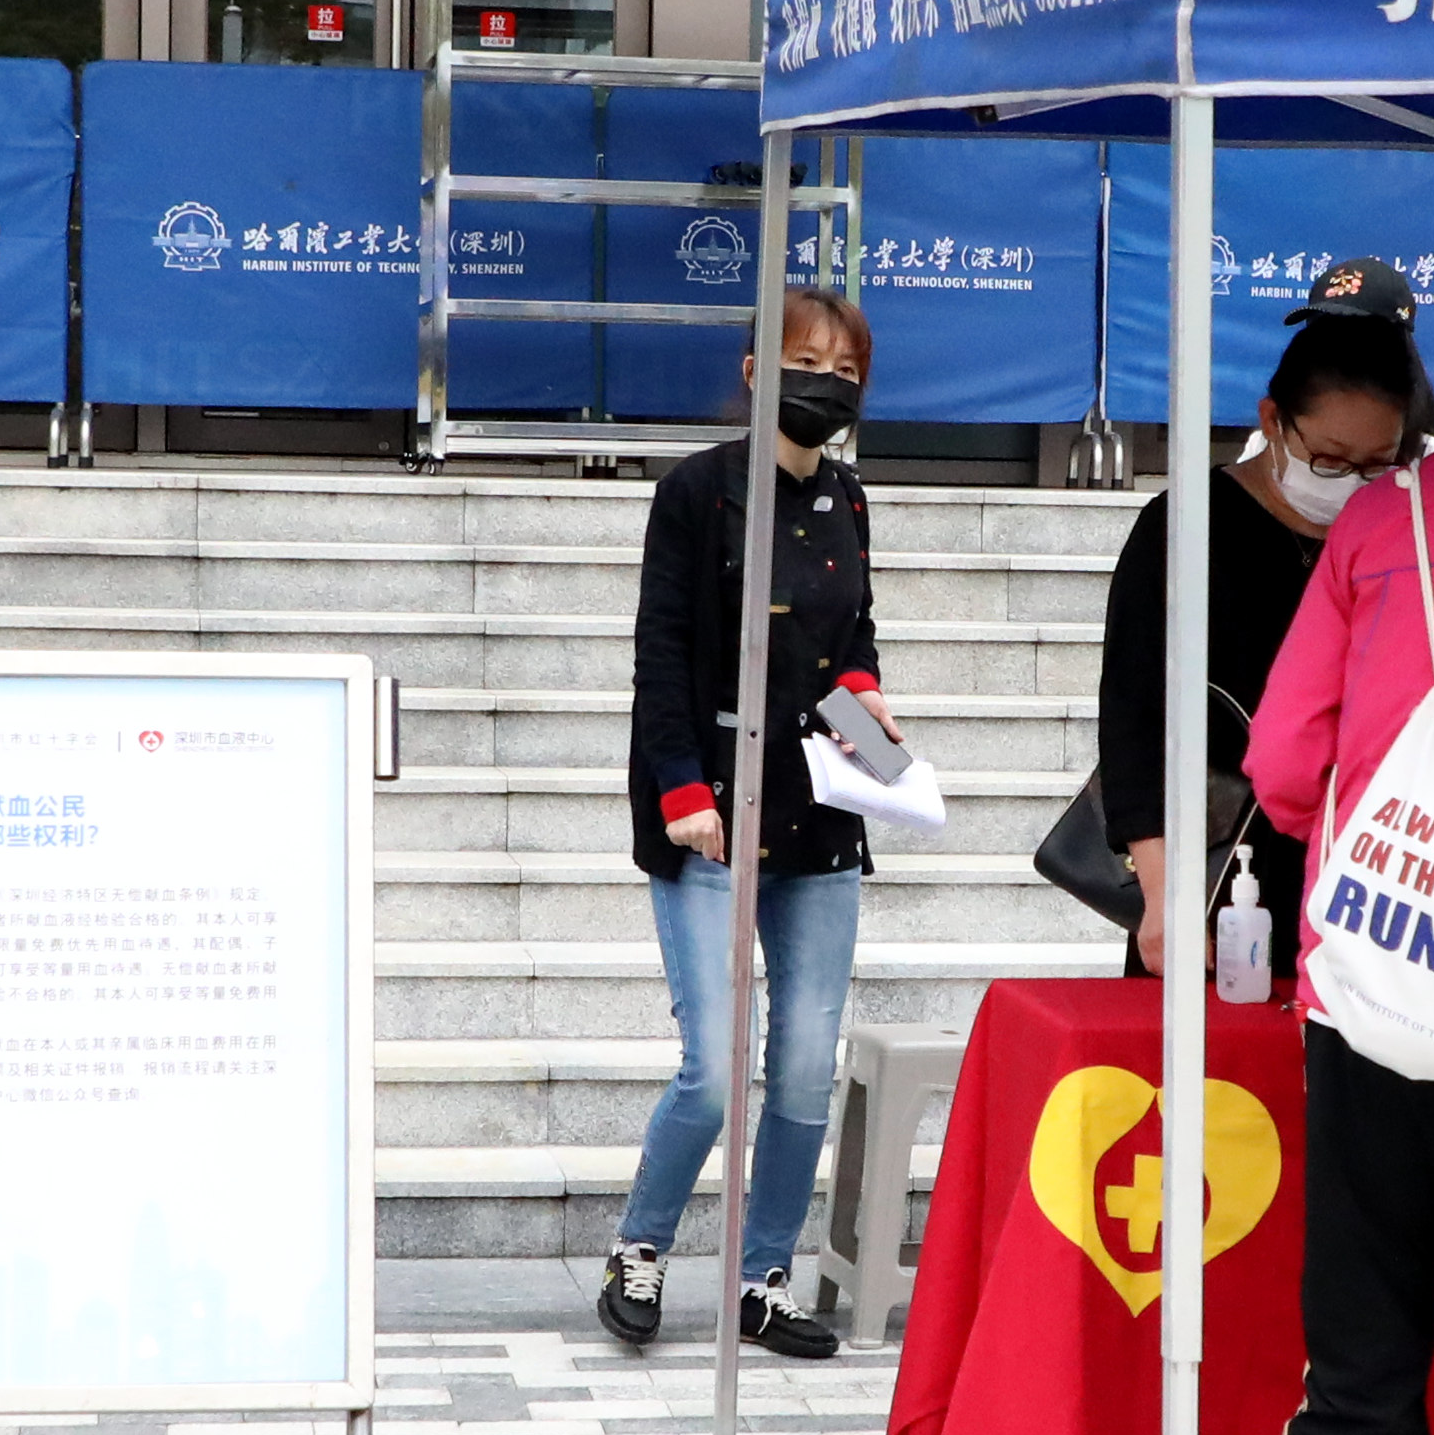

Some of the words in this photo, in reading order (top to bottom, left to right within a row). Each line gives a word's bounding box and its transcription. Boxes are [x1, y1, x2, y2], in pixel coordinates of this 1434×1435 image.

[317, 7, 335, 25] 拉
[489, 14, 506, 31] 拉
[243, 259, 288, 272] HARBIN
[292, 260, 352, 273] INSTITUTE
[357, 261, 372, 273] OF
[461, 263, 524, 275] SHENZHEN
[873, 275, 888, 287] OF
[973, 279, 1032, 291] SHENZHEN
[1251, 286, 1293, 298] HARBIN
[174, 730, 274, 745] 深圳市血液中心
[1350, 831, 1394, 875] ON
[1411, 1020, 1427, 1034] OF
